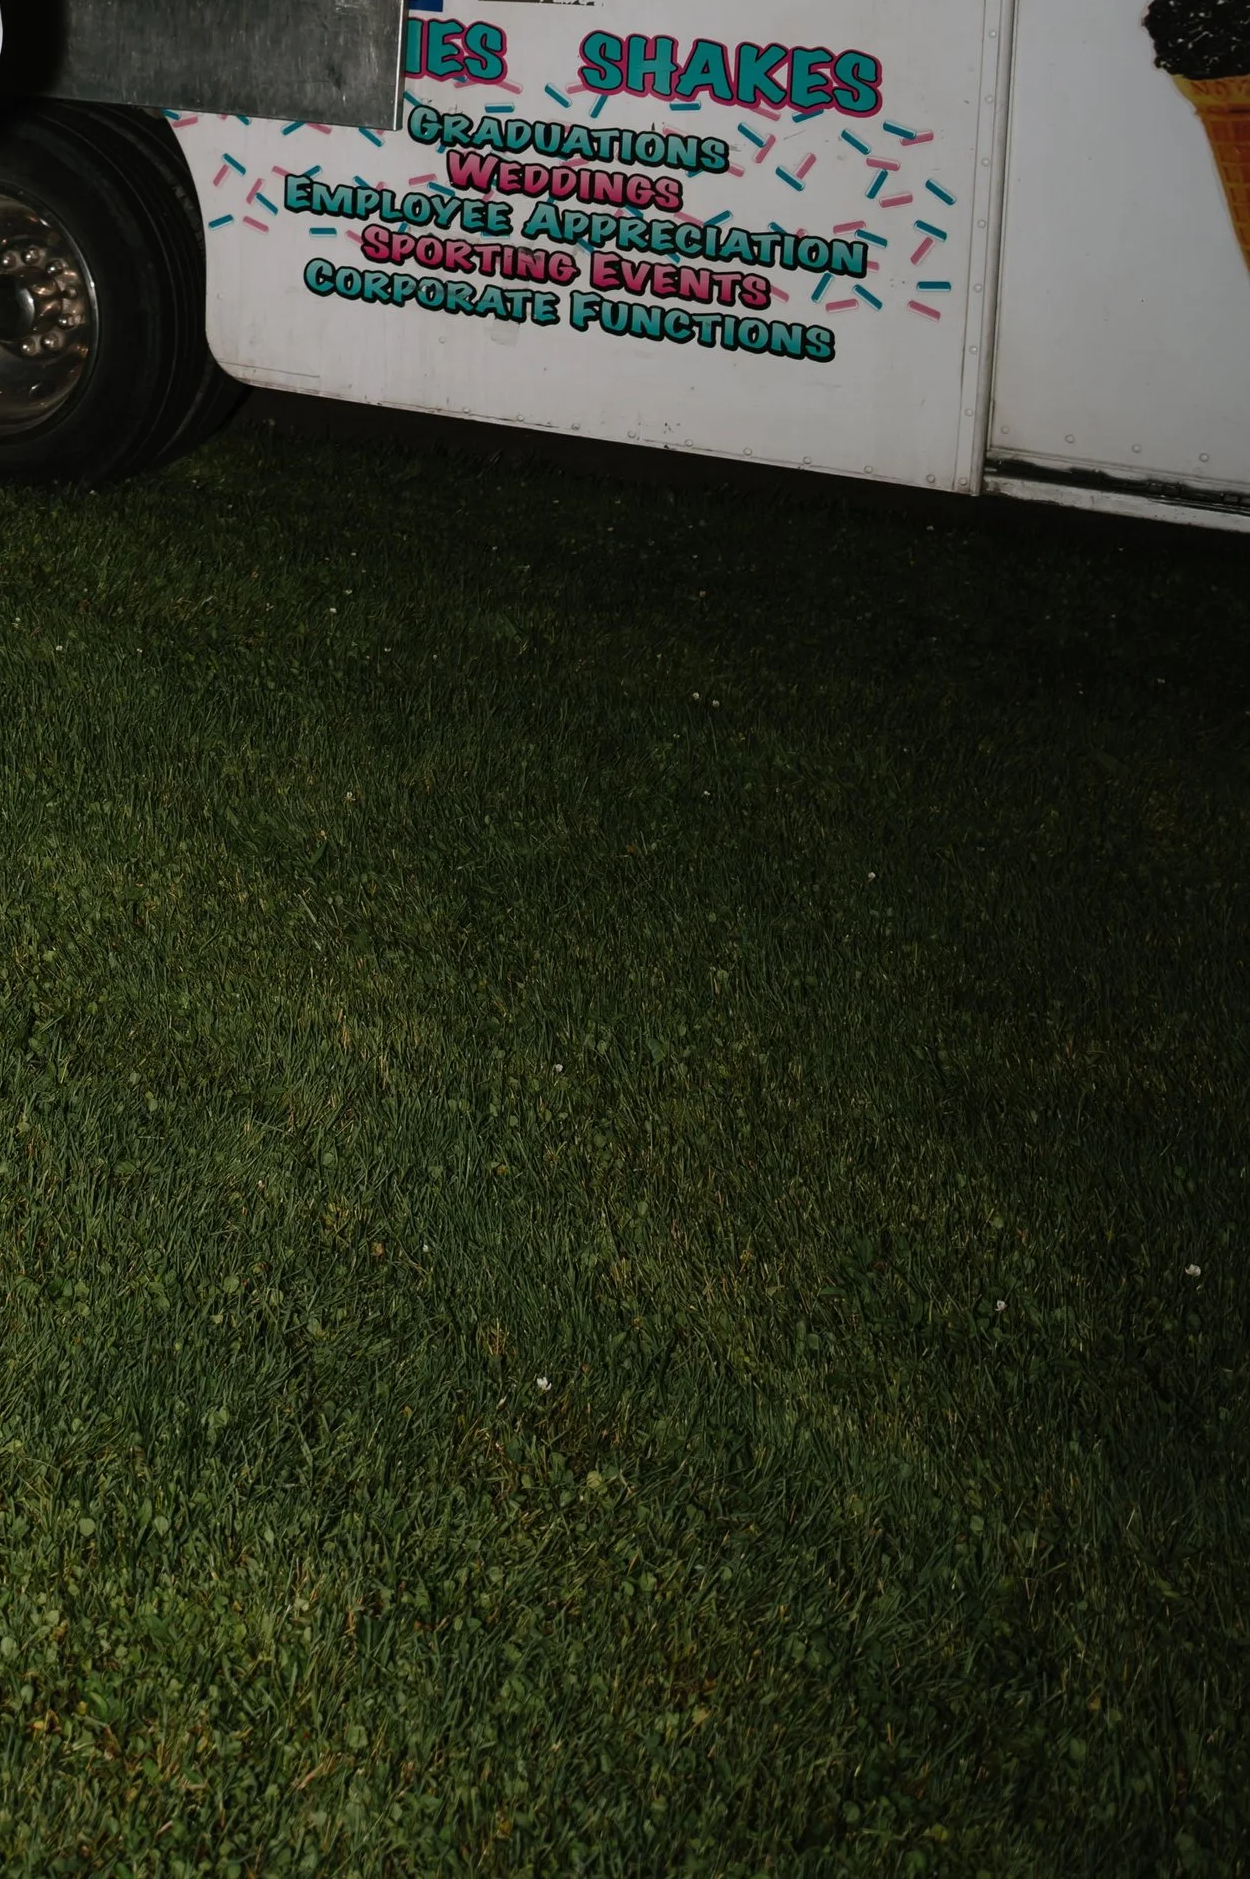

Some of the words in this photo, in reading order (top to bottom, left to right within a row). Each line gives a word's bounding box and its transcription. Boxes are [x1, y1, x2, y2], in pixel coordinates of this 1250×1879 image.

[579, 29, 882, 118] SHAKES
[407, 104, 729, 173] GRADUATIONS
[447, 149, 683, 213] WEDDINGS
[283, 174, 512, 234] EMPLOYEE
[523, 199, 870, 278] APPRECIATION
[360, 223, 579, 286] SPORTING
[589, 250, 771, 310] EVENTS
[302, 257, 561, 326] CORPORATE
[569, 290, 836, 363] FUNCTIONS
